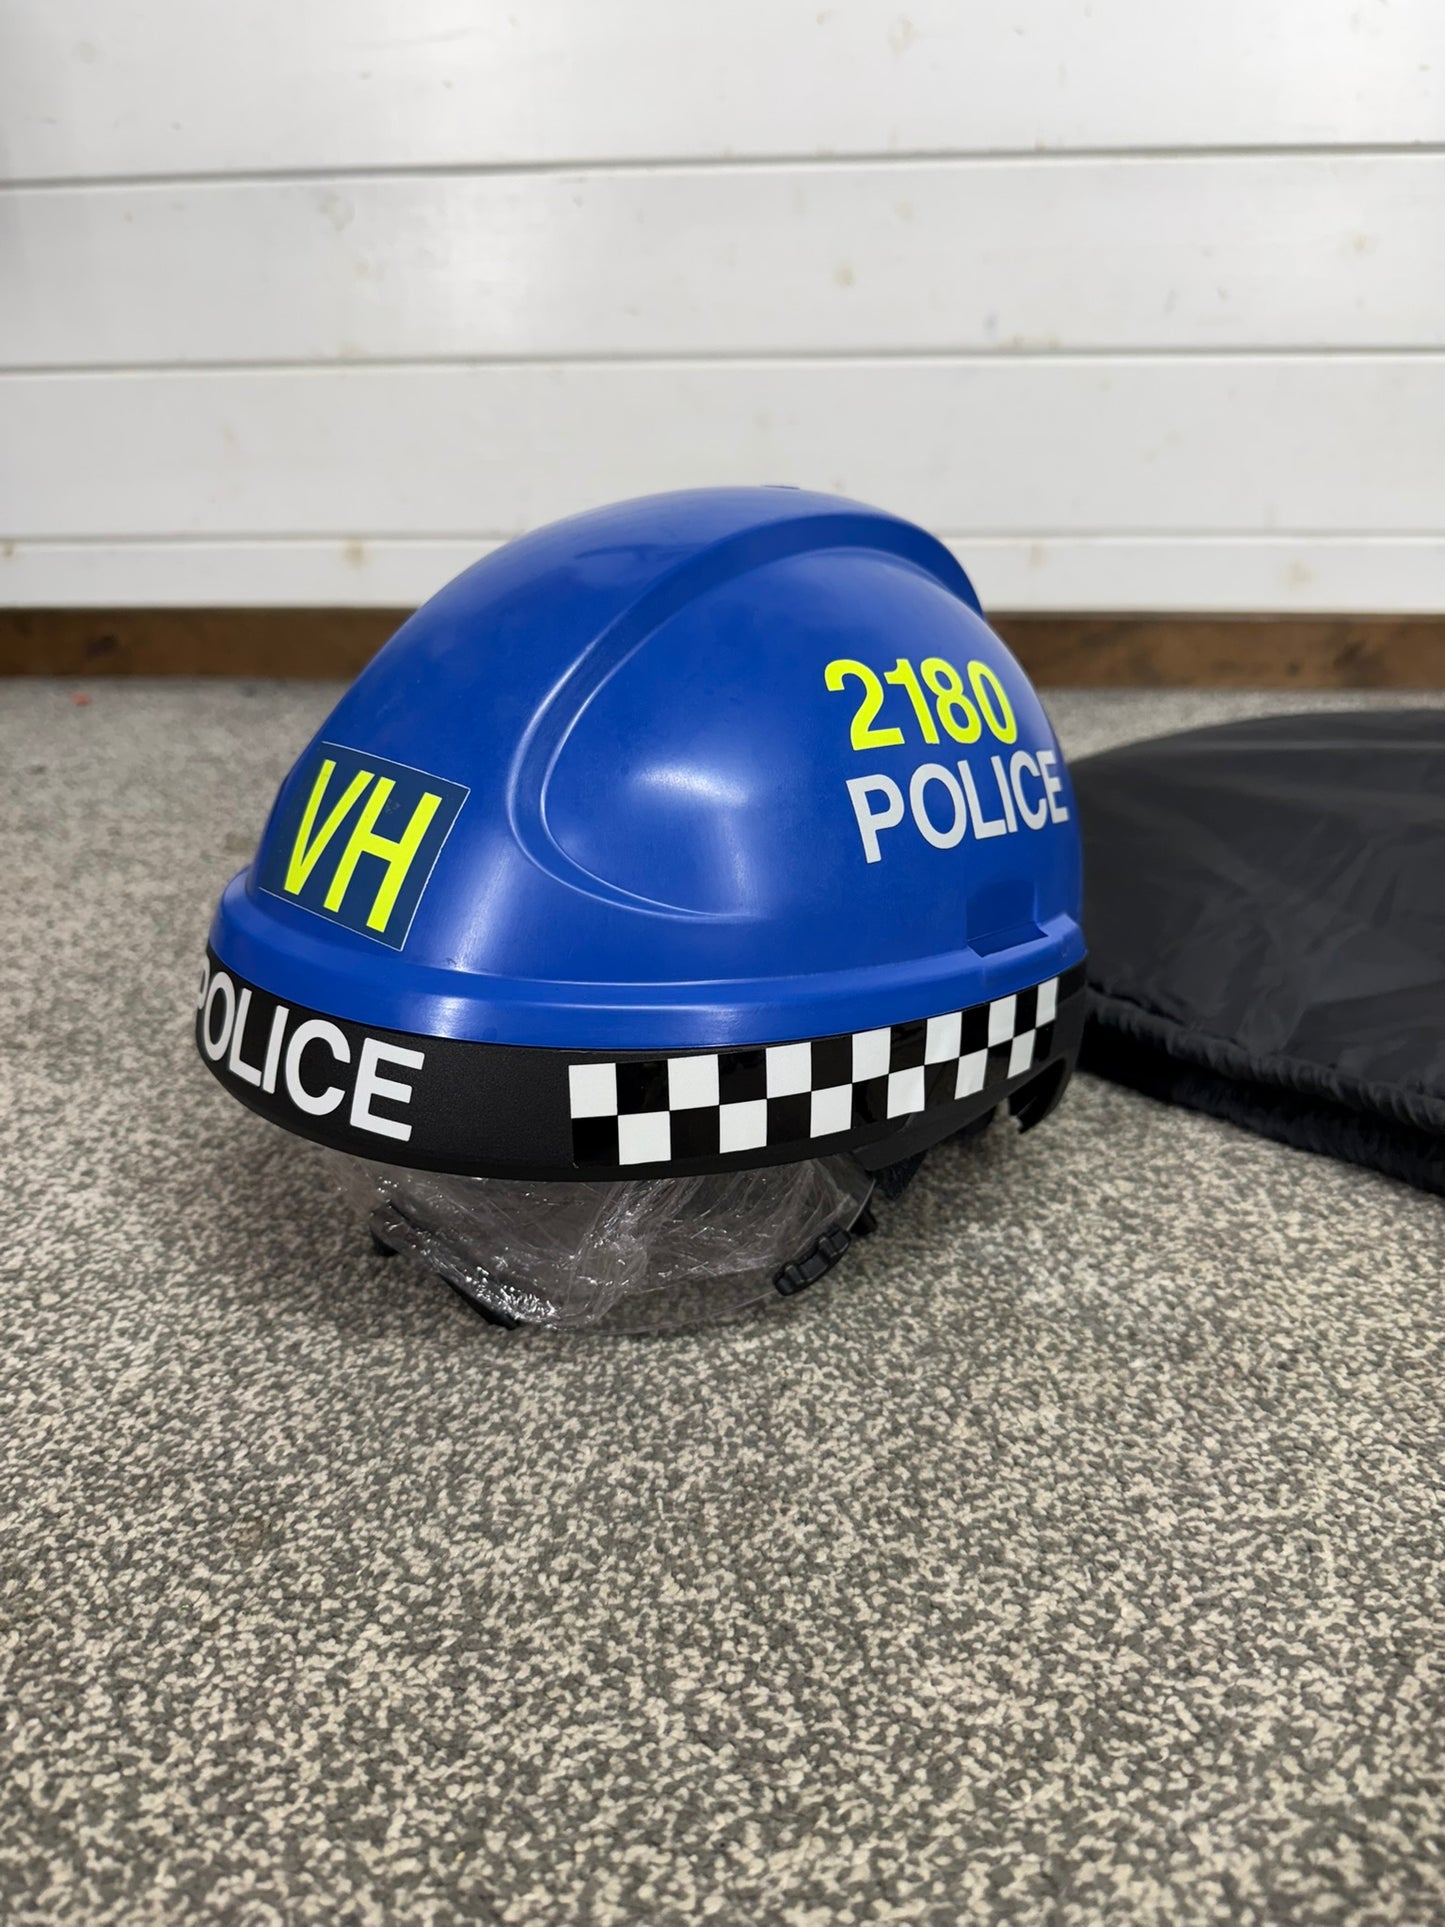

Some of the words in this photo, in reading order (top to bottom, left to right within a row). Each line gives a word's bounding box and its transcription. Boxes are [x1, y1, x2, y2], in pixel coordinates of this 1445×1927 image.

[825, 658, 1018, 750] 2180
[283, 759, 442, 933] VH
[845, 749, 1069, 864] POLICE
